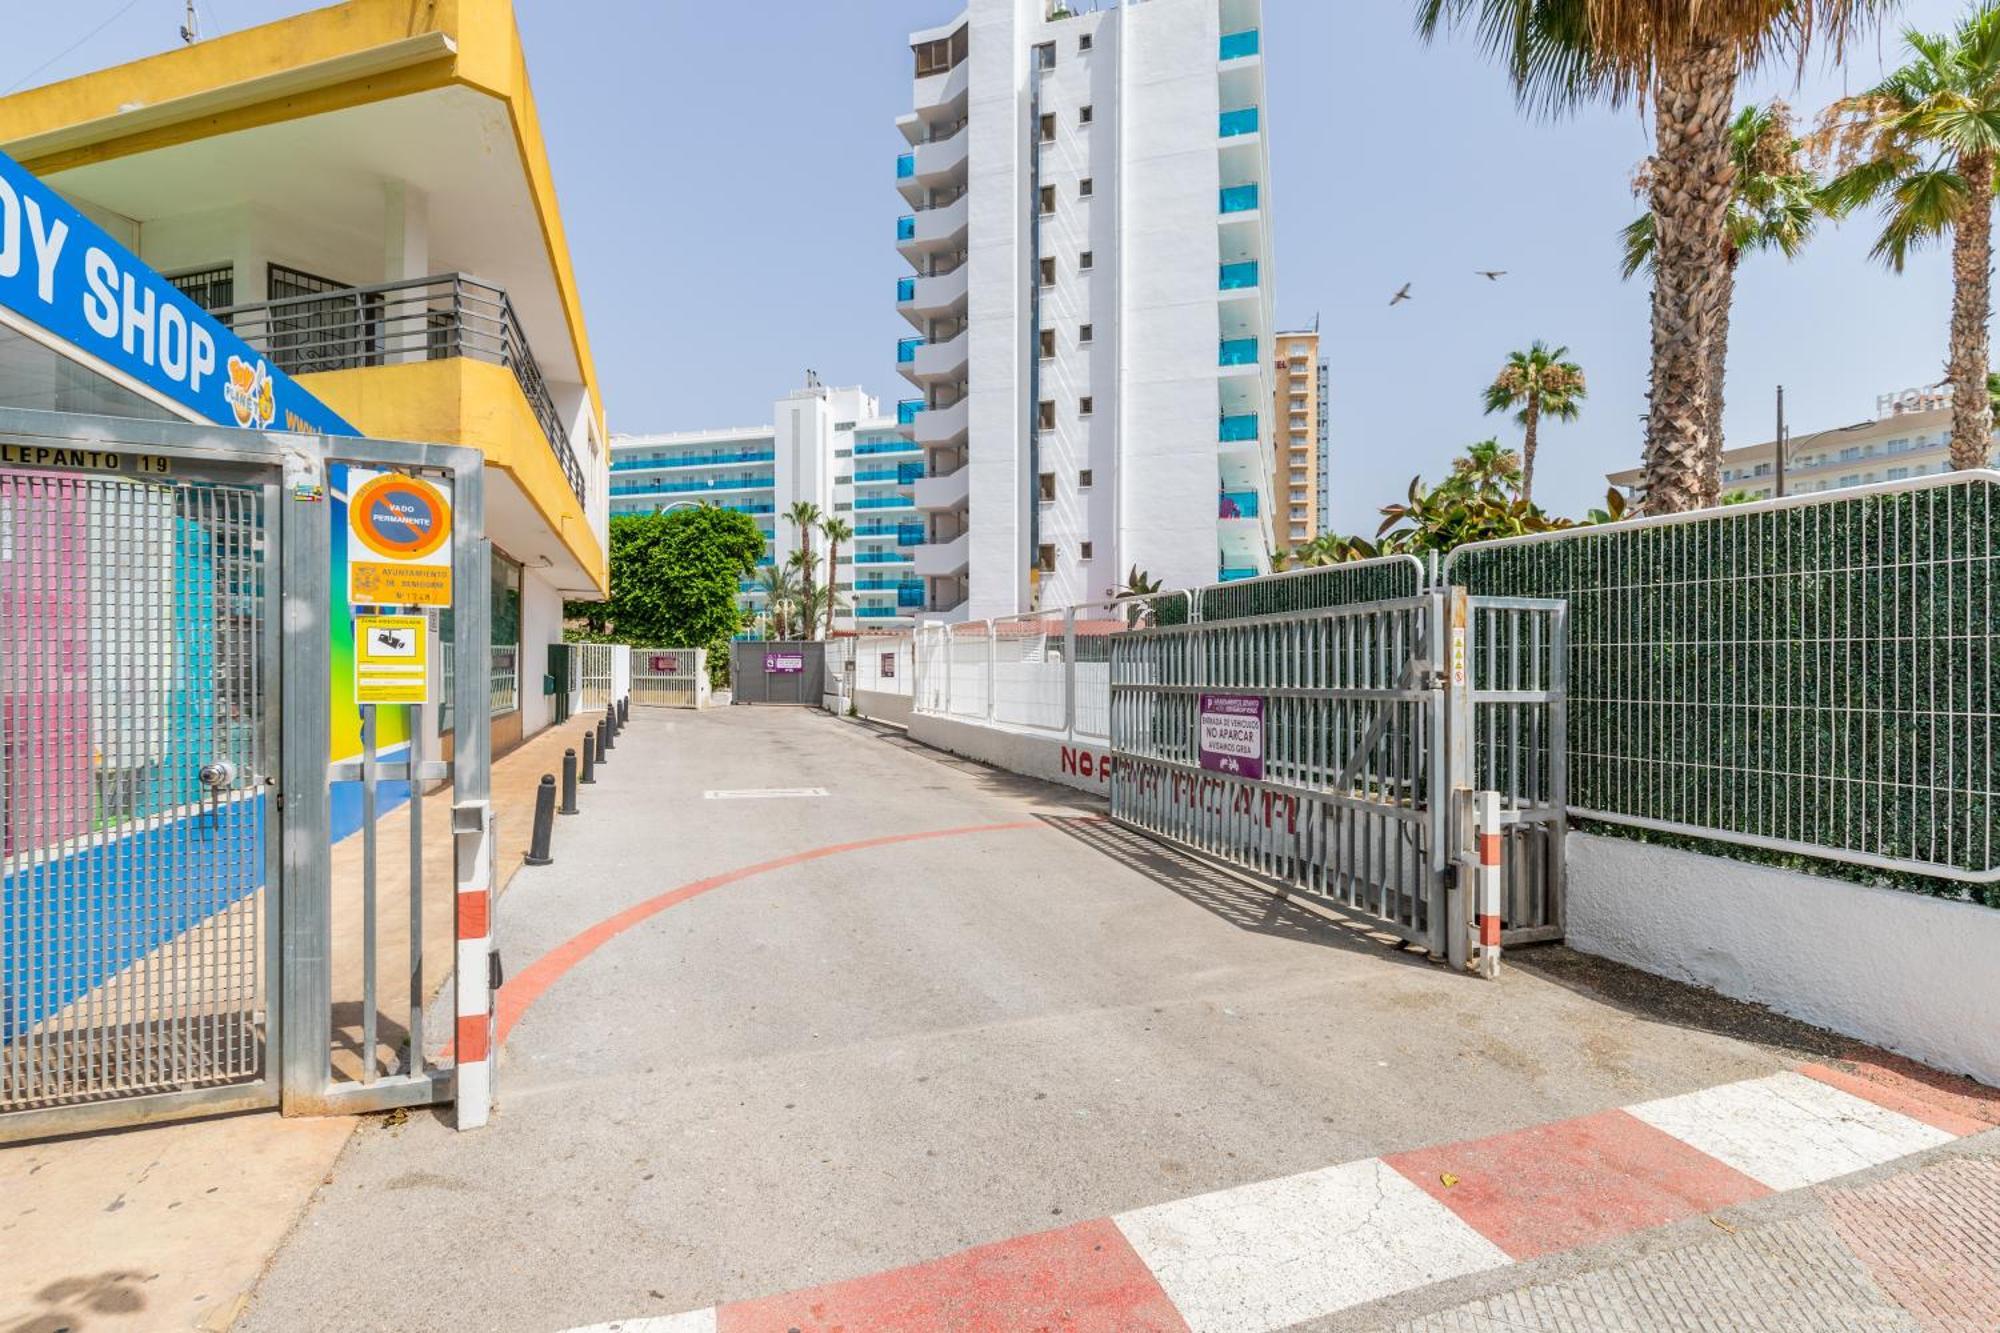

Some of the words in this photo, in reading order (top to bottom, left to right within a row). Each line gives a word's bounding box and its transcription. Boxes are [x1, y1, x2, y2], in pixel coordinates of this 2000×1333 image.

[83, 247, 215, 393] SHOP
[2, 444, 119, 469] LEPANTO
[142, 455, 167, 472] 19
[389, 503, 415, 513] VADO
[372, 514, 431, 527] PERMANENTE
[1206, 727, 1217, 738] NO
[1219, 729, 1254, 743] APARCAR
[1061, 745, 1093, 777] NO
